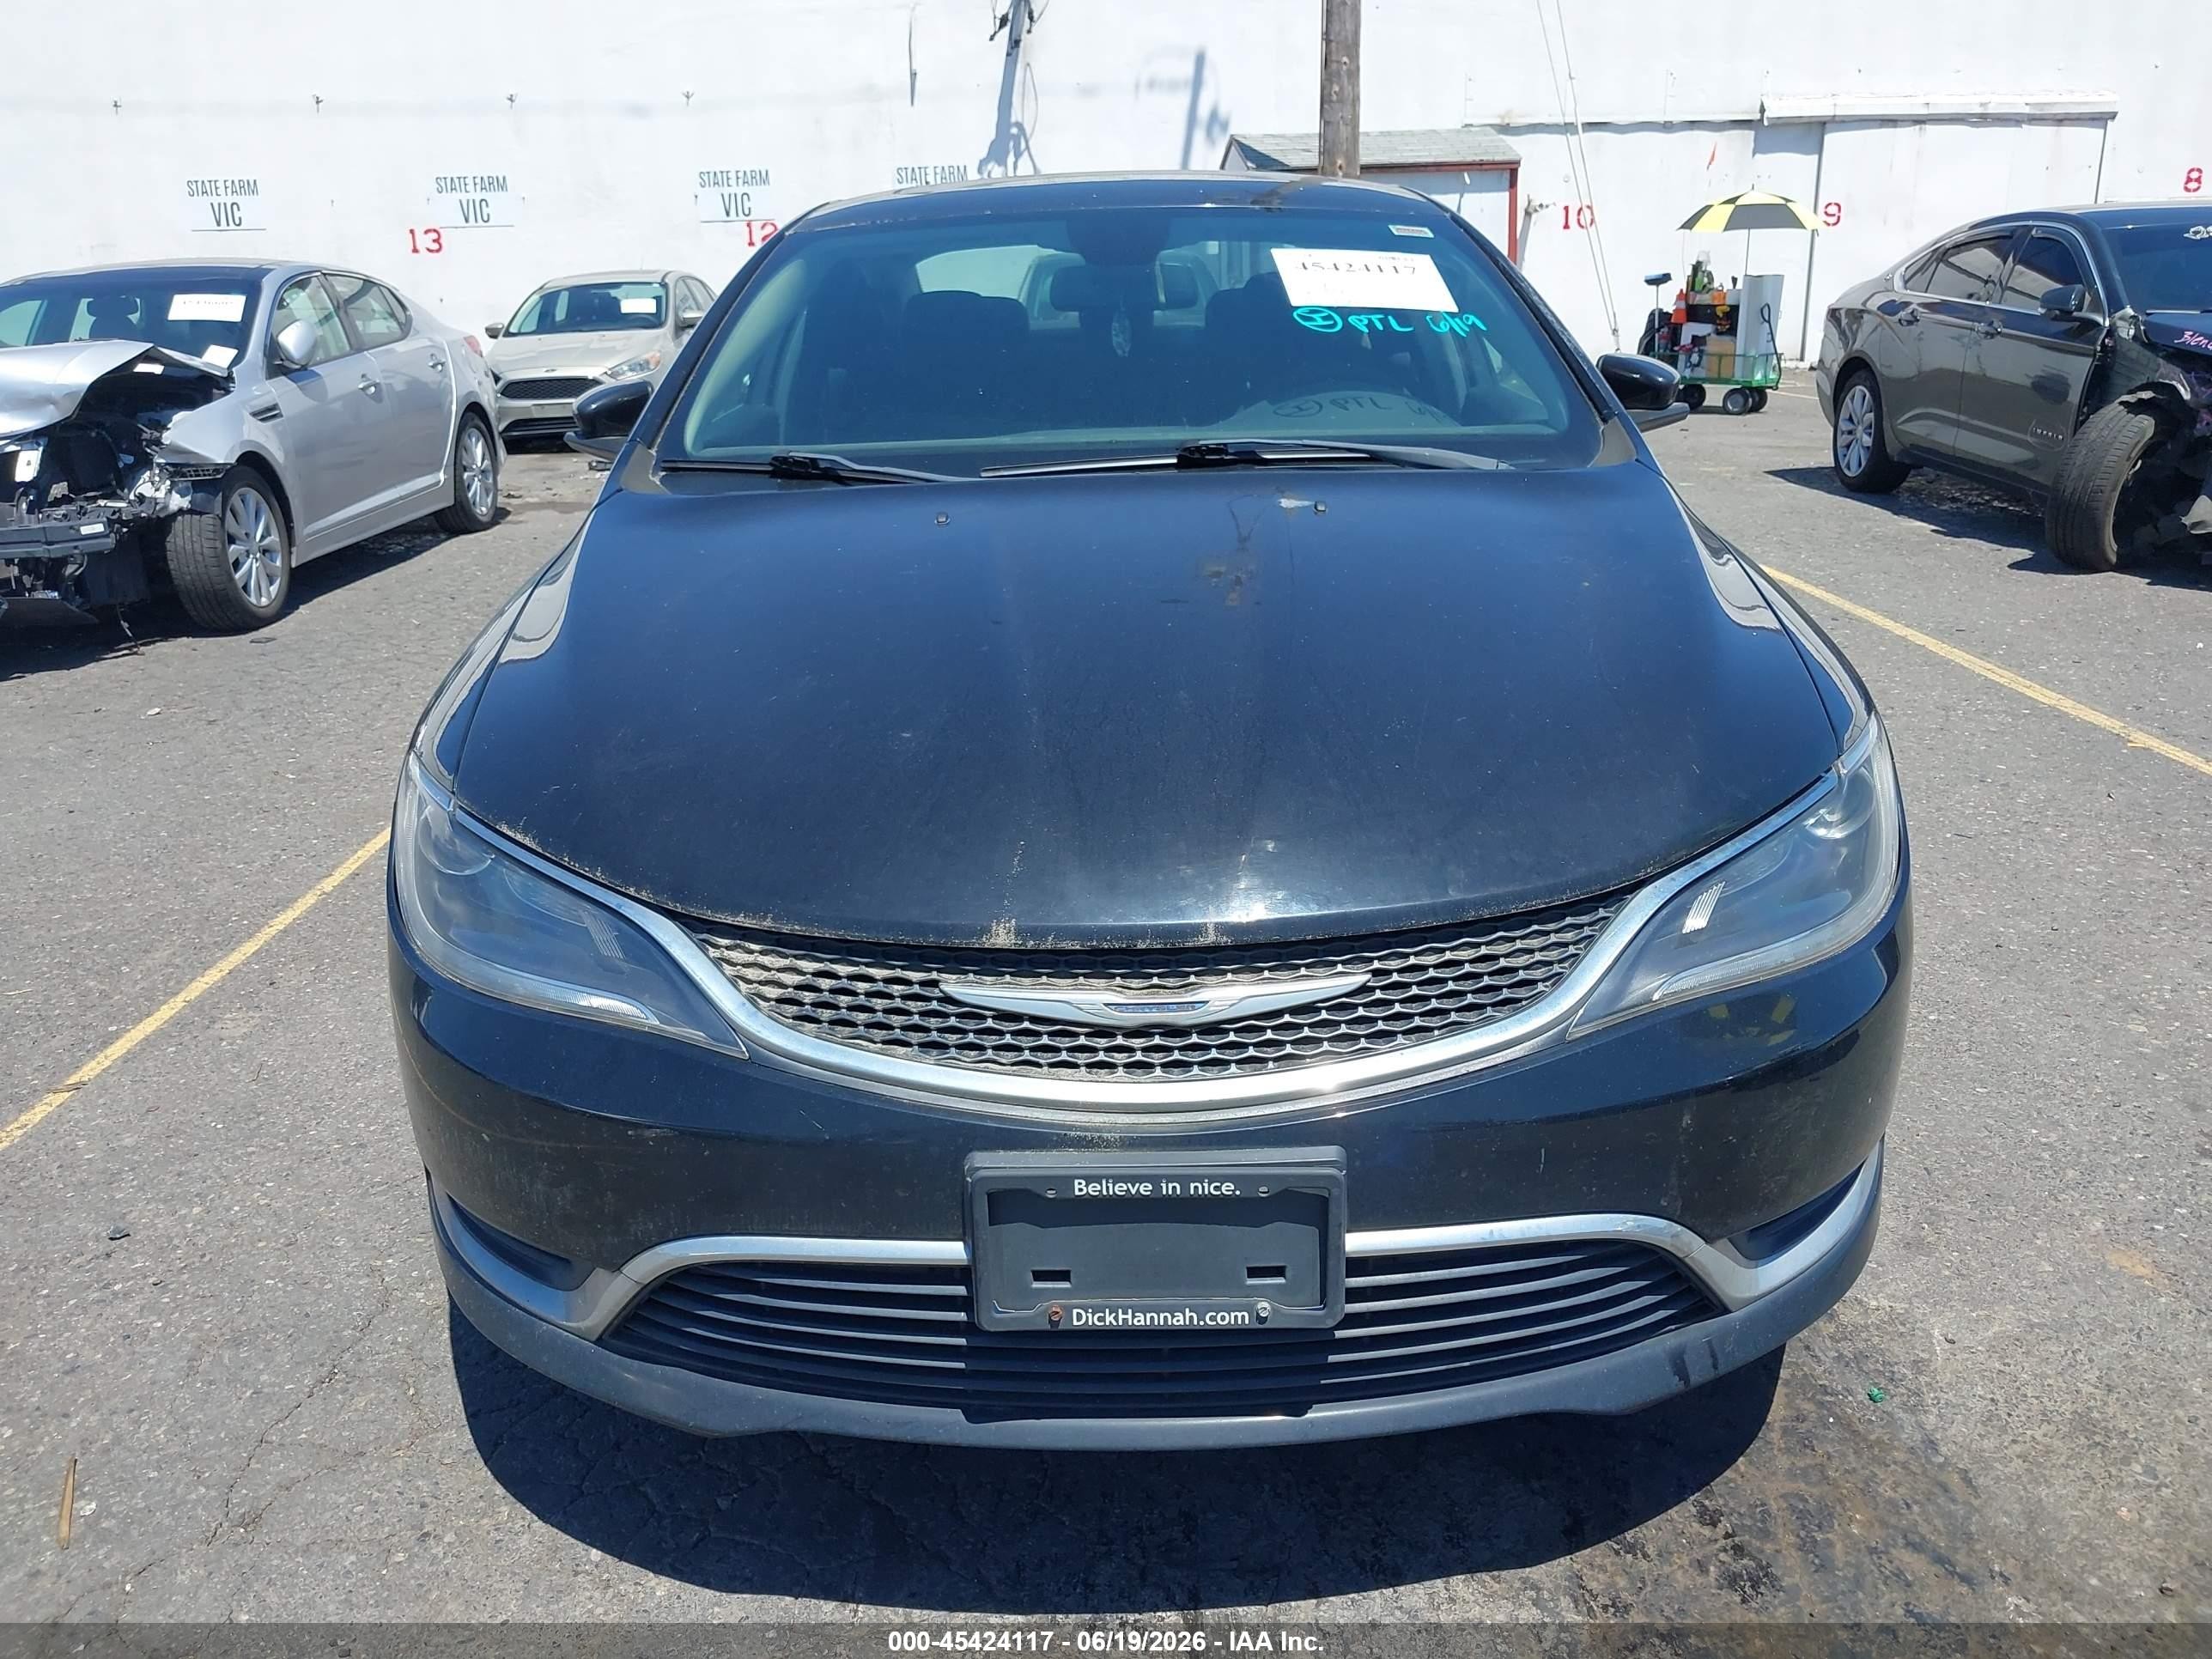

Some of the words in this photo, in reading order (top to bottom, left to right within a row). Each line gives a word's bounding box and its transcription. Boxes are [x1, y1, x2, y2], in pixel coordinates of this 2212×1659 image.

[435, 176, 471, 193] STATE
[472, 175, 507, 192] FARM
[699, 170, 733, 188] STATE
[736, 169, 769, 187] FARM
[896, 166, 930, 185] STATE
[933, 164, 968, 185] FARM
[2184, 167, 2203, 192] 8
[186, 179, 222, 198] STATE
[223, 179, 258, 197] FARM
[210, 202, 242, 227] VIC
[459, 198, 490, 223] VIC
[720, 192, 751, 217] VIC
[1822, 202, 1842, 227] 9
[1563, 205, 1595, 230] 10
[409, 228, 443, 253] 13
[746, 221, 778, 246] 12
[1073, 1178, 1153, 1196] Believe
[1160, 1178, 1181, 1195] in
[1189, 1179, 1241, 1195] nice.
[1073, 1307, 1249, 1326] DickHannah.com
